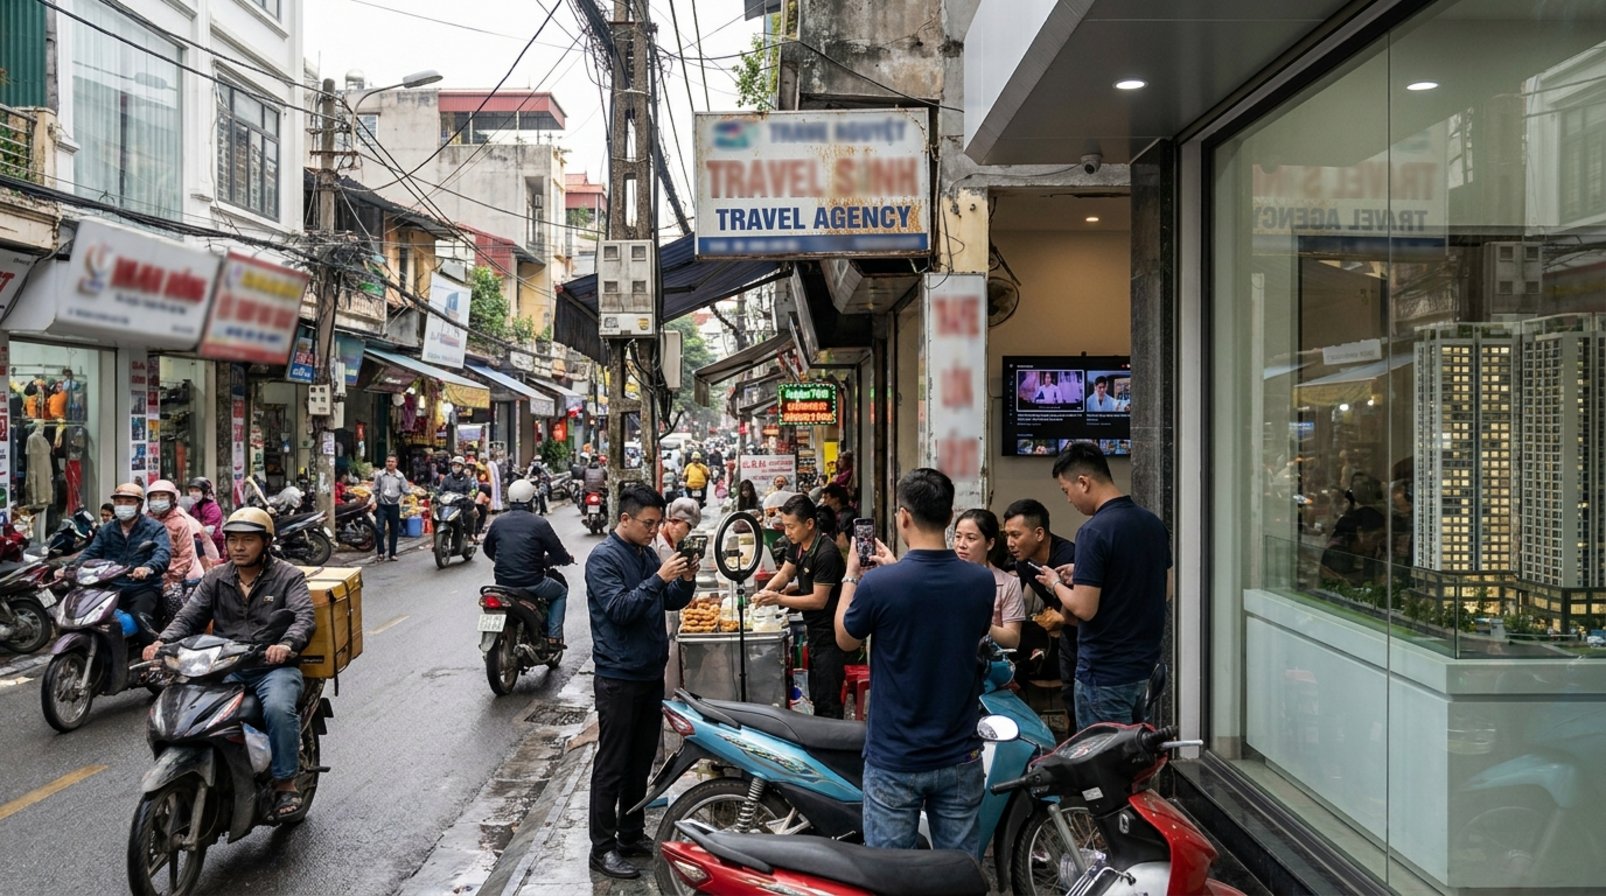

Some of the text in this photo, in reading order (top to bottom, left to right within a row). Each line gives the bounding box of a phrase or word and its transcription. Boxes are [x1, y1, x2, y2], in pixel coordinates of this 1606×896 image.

[706, 159, 823, 199] TRAVEL
[715, 205, 912, 231] TRAVEL AGENCY
